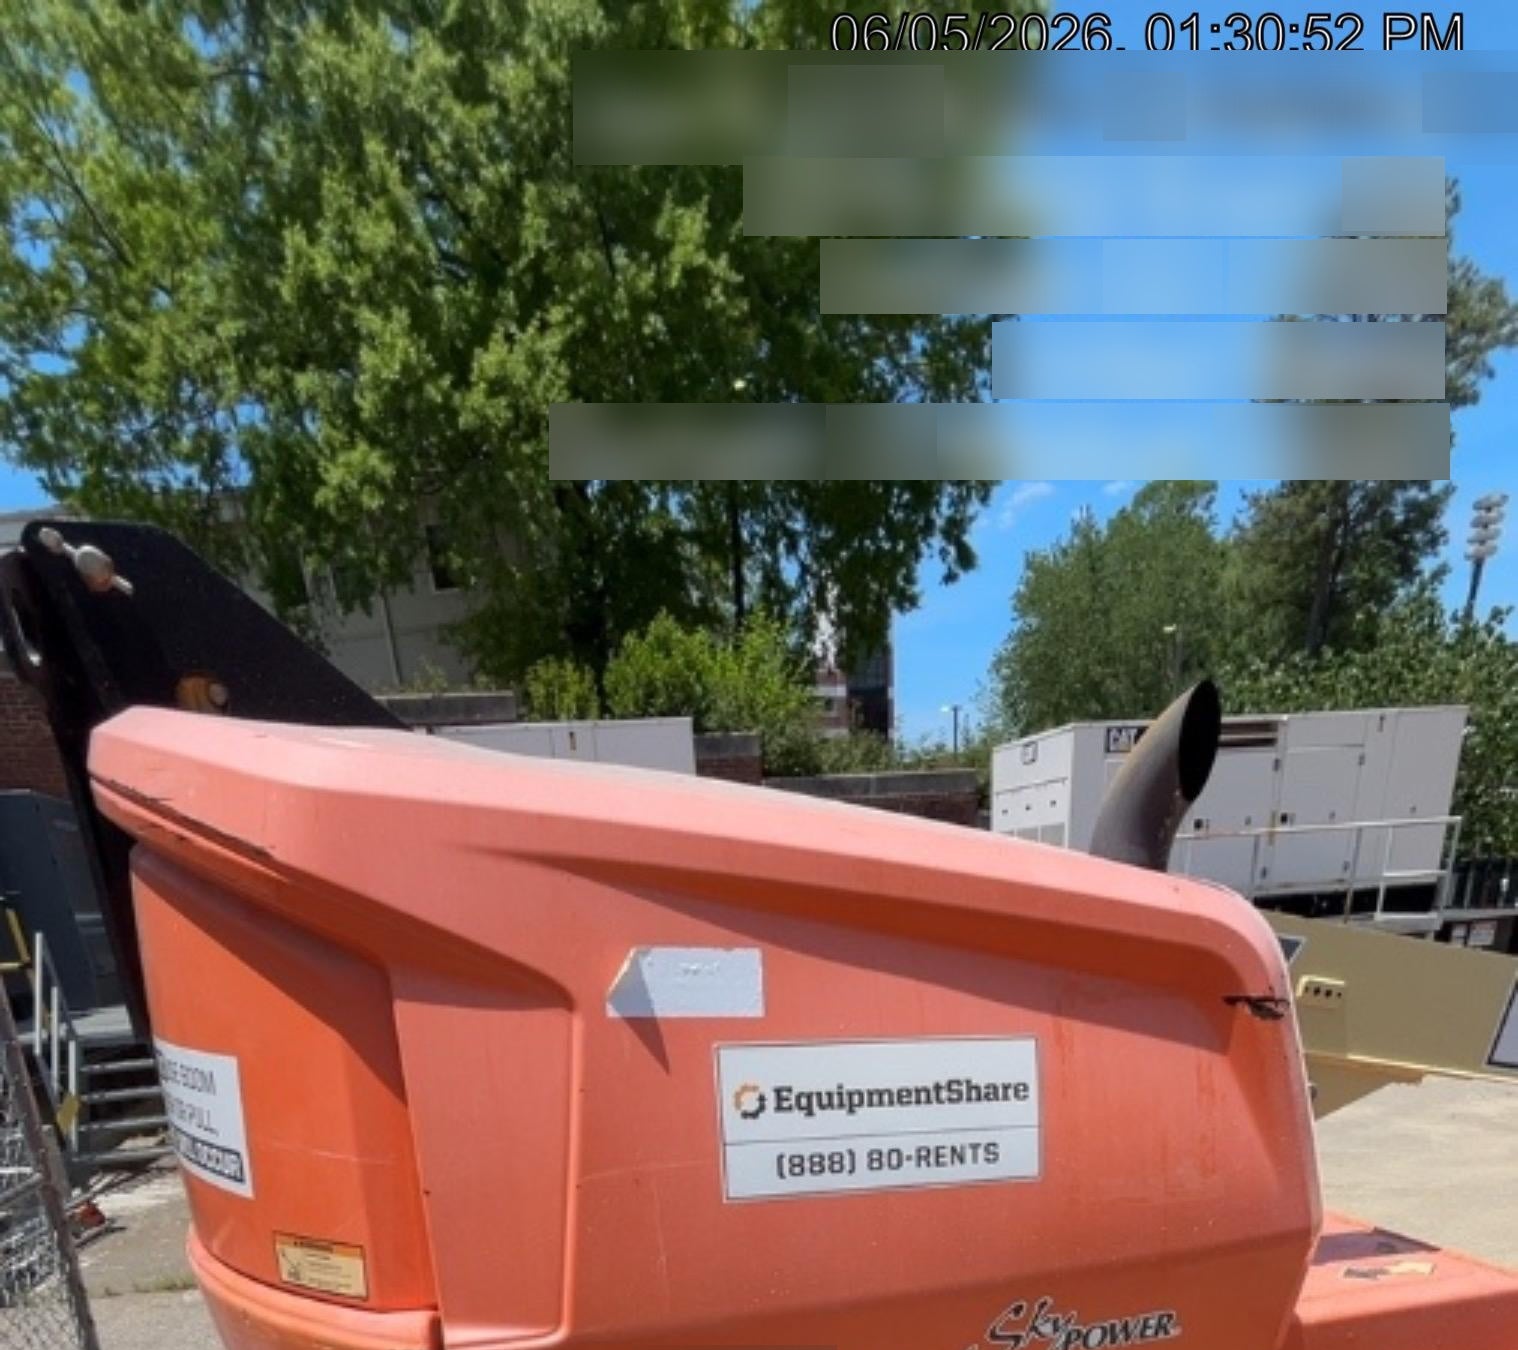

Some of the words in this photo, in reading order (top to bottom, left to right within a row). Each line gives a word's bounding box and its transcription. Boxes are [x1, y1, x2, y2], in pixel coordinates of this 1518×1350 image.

[1109, 728, 1138, 751] CAT
[772, 1078, 1029, 1117] EquipmentShare
[776, 1149, 856, 1179] (888)
[867, 1142, 1000, 1171] 80-RENTS
